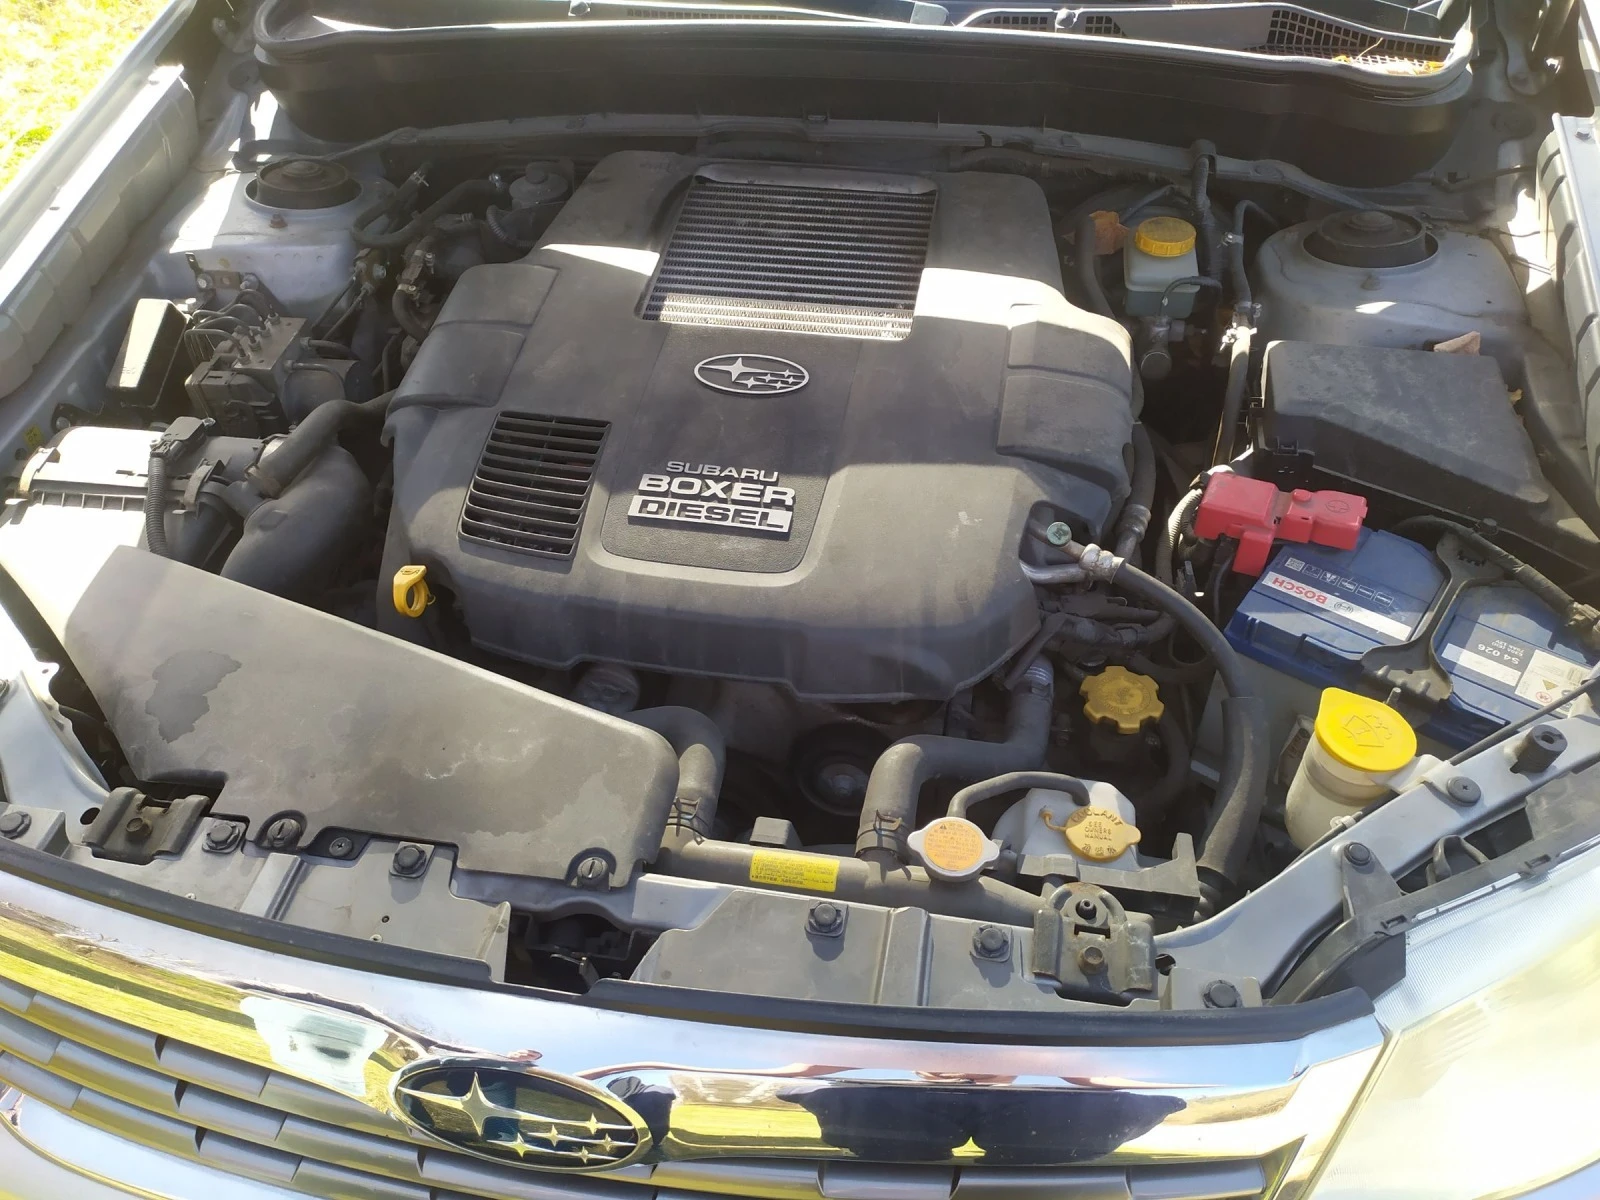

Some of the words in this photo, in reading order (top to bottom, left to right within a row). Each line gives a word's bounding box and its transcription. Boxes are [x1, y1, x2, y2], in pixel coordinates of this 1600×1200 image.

[666, 461, 778, 482] SUBARU
[638, 473, 796, 506] BOXER
[637, 498, 784, 529] DIESEL
[1272, 577, 1328, 605] BOSCH
[1478, 643, 1500, 656] 026
[1503, 654, 1520, 664] S4
[1071, 808, 1123, 826] COOLANT
[1084, 834, 1112, 842] MANUAL
